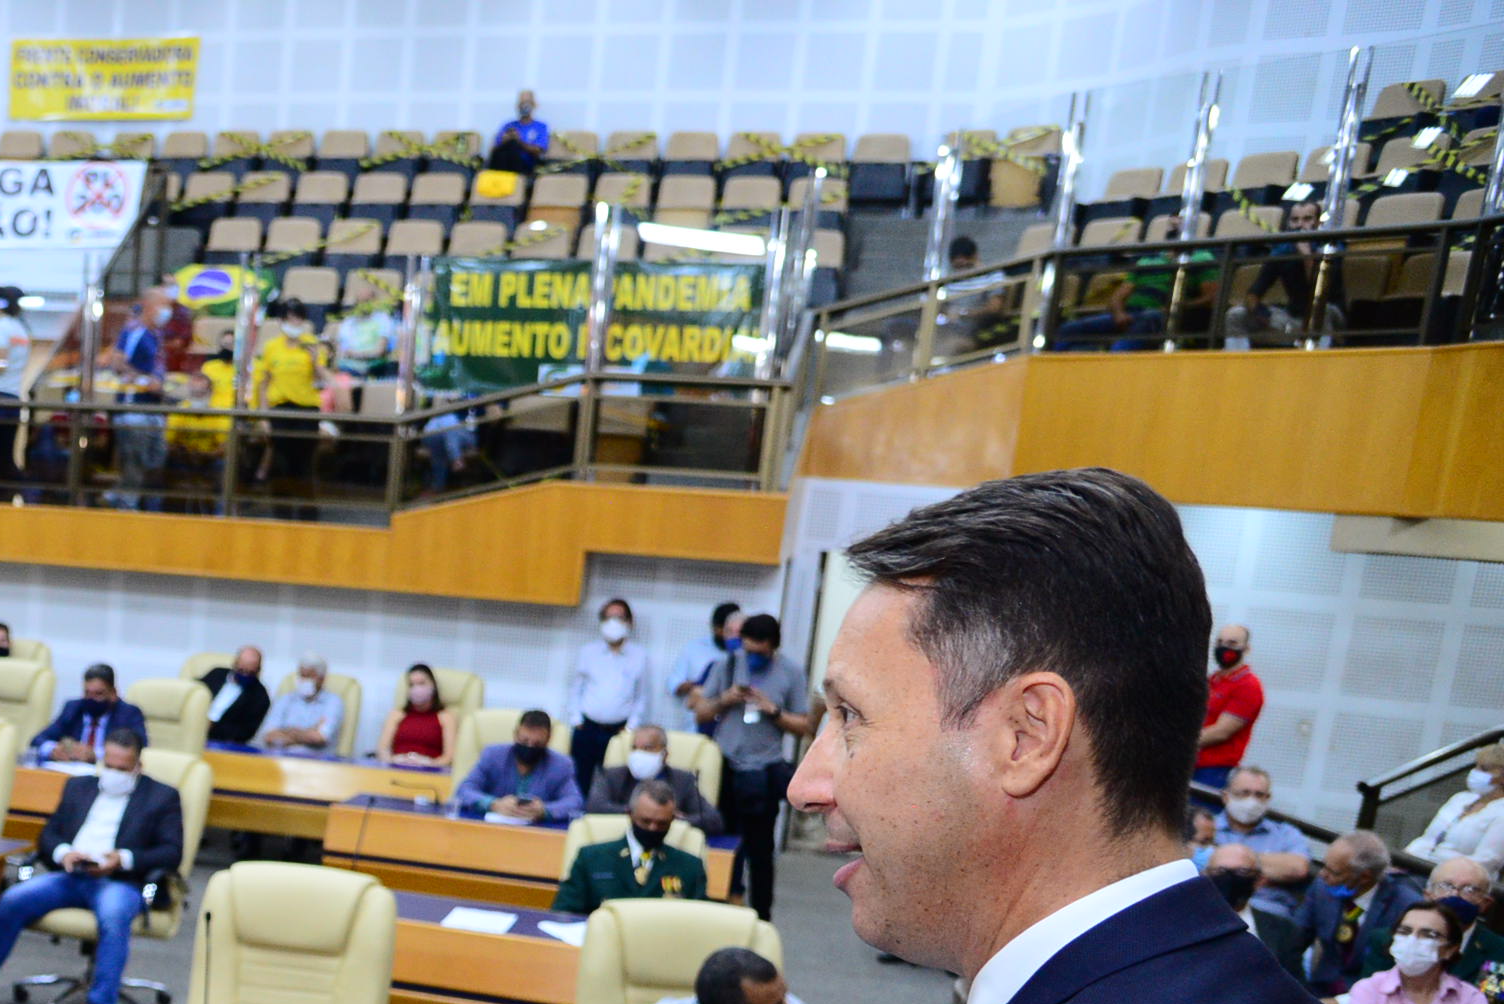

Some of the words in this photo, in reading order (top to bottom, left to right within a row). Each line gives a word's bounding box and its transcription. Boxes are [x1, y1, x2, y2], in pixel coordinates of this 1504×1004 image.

[450, 272, 493, 307] EM
[498, 272, 590, 311] PLENA
[611, 272, 752, 312] ANDEMIA
[432, 319, 572, 361] AUMENTO
